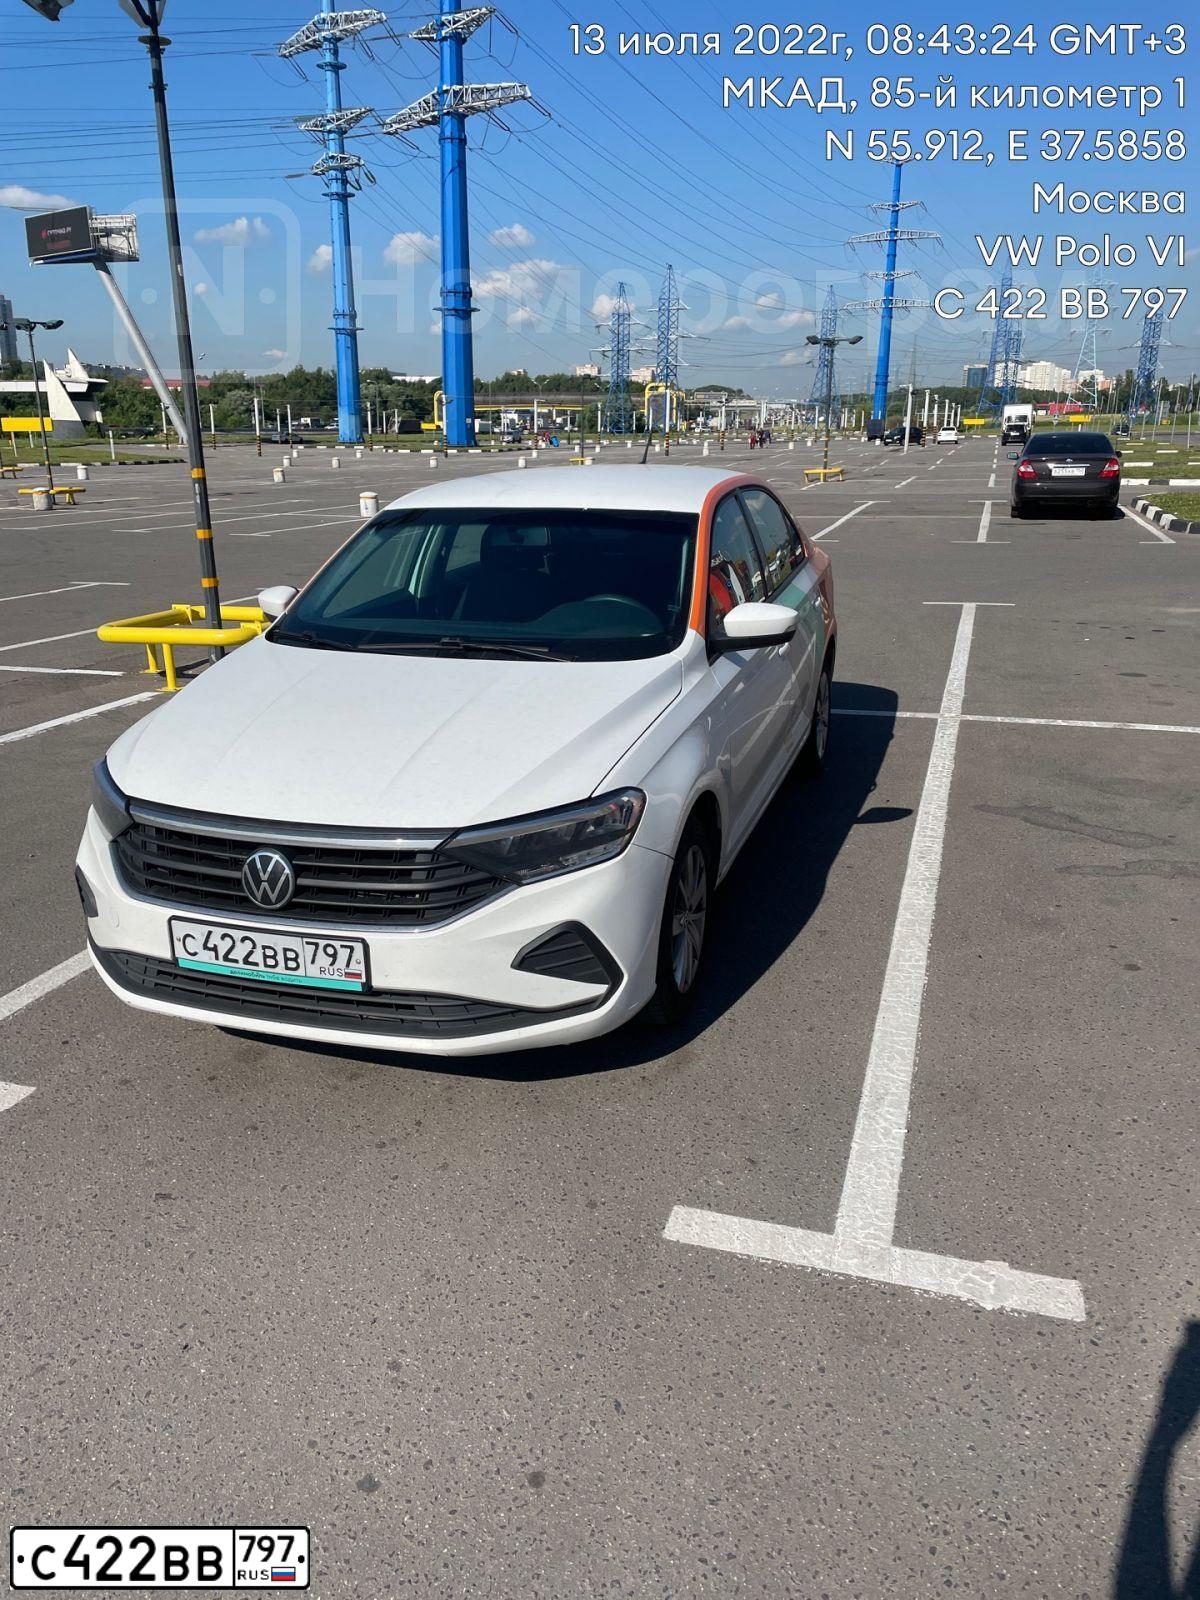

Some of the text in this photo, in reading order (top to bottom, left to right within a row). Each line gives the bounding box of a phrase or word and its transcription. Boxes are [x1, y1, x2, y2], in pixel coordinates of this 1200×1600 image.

[182, 930, 300, 972] С422ВВ
[305, 940, 355, 969] 797
[319, 967, 344, 978] RUS
